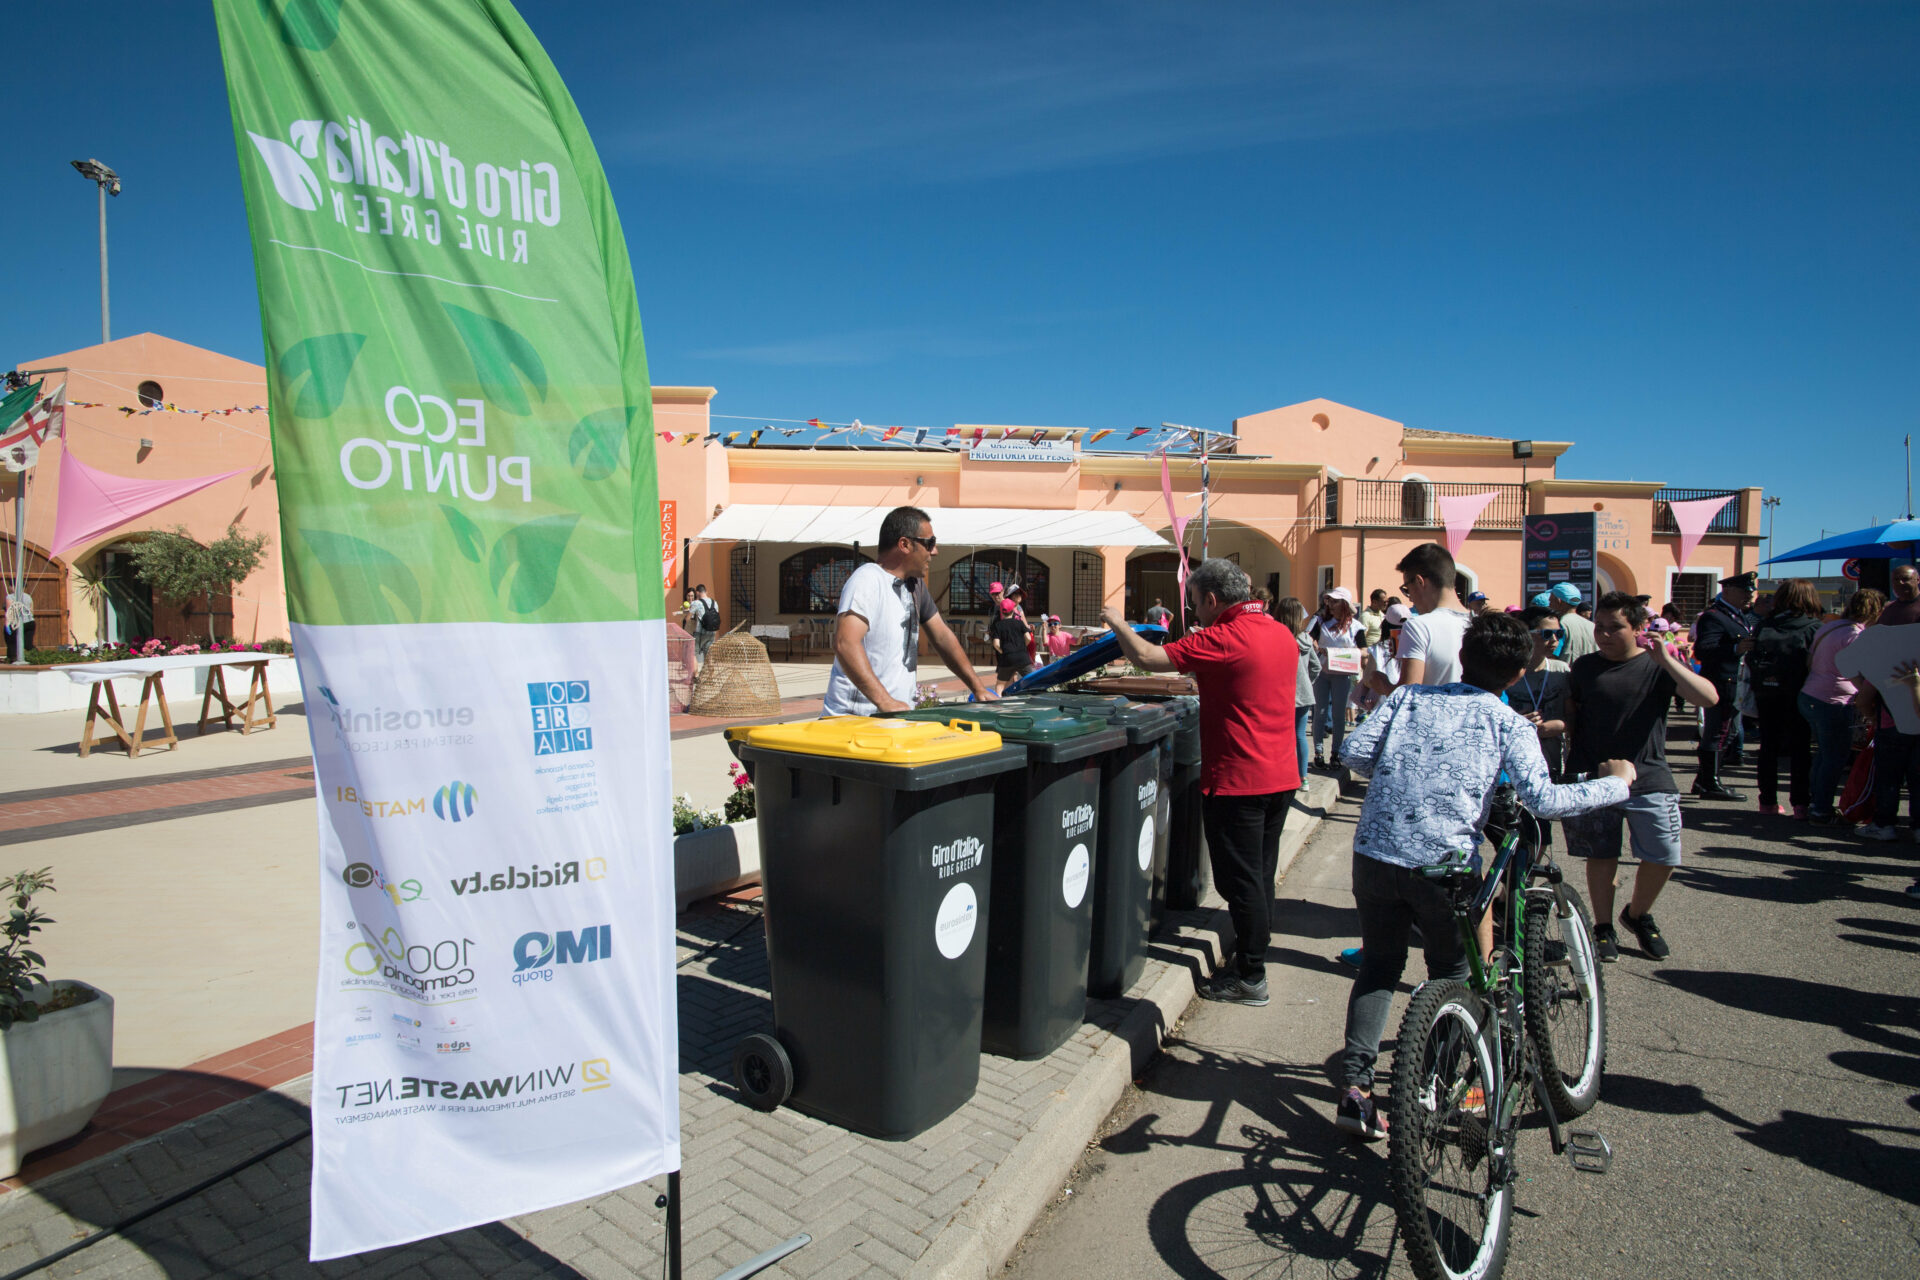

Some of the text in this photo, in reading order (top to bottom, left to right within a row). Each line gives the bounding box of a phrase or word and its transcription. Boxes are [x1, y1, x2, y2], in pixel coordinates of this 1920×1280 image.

[662, 503, 673, 587] PESCHEA
[932, 845, 950, 867] Giro
[939, 859, 974, 879] RIDE GREEN
